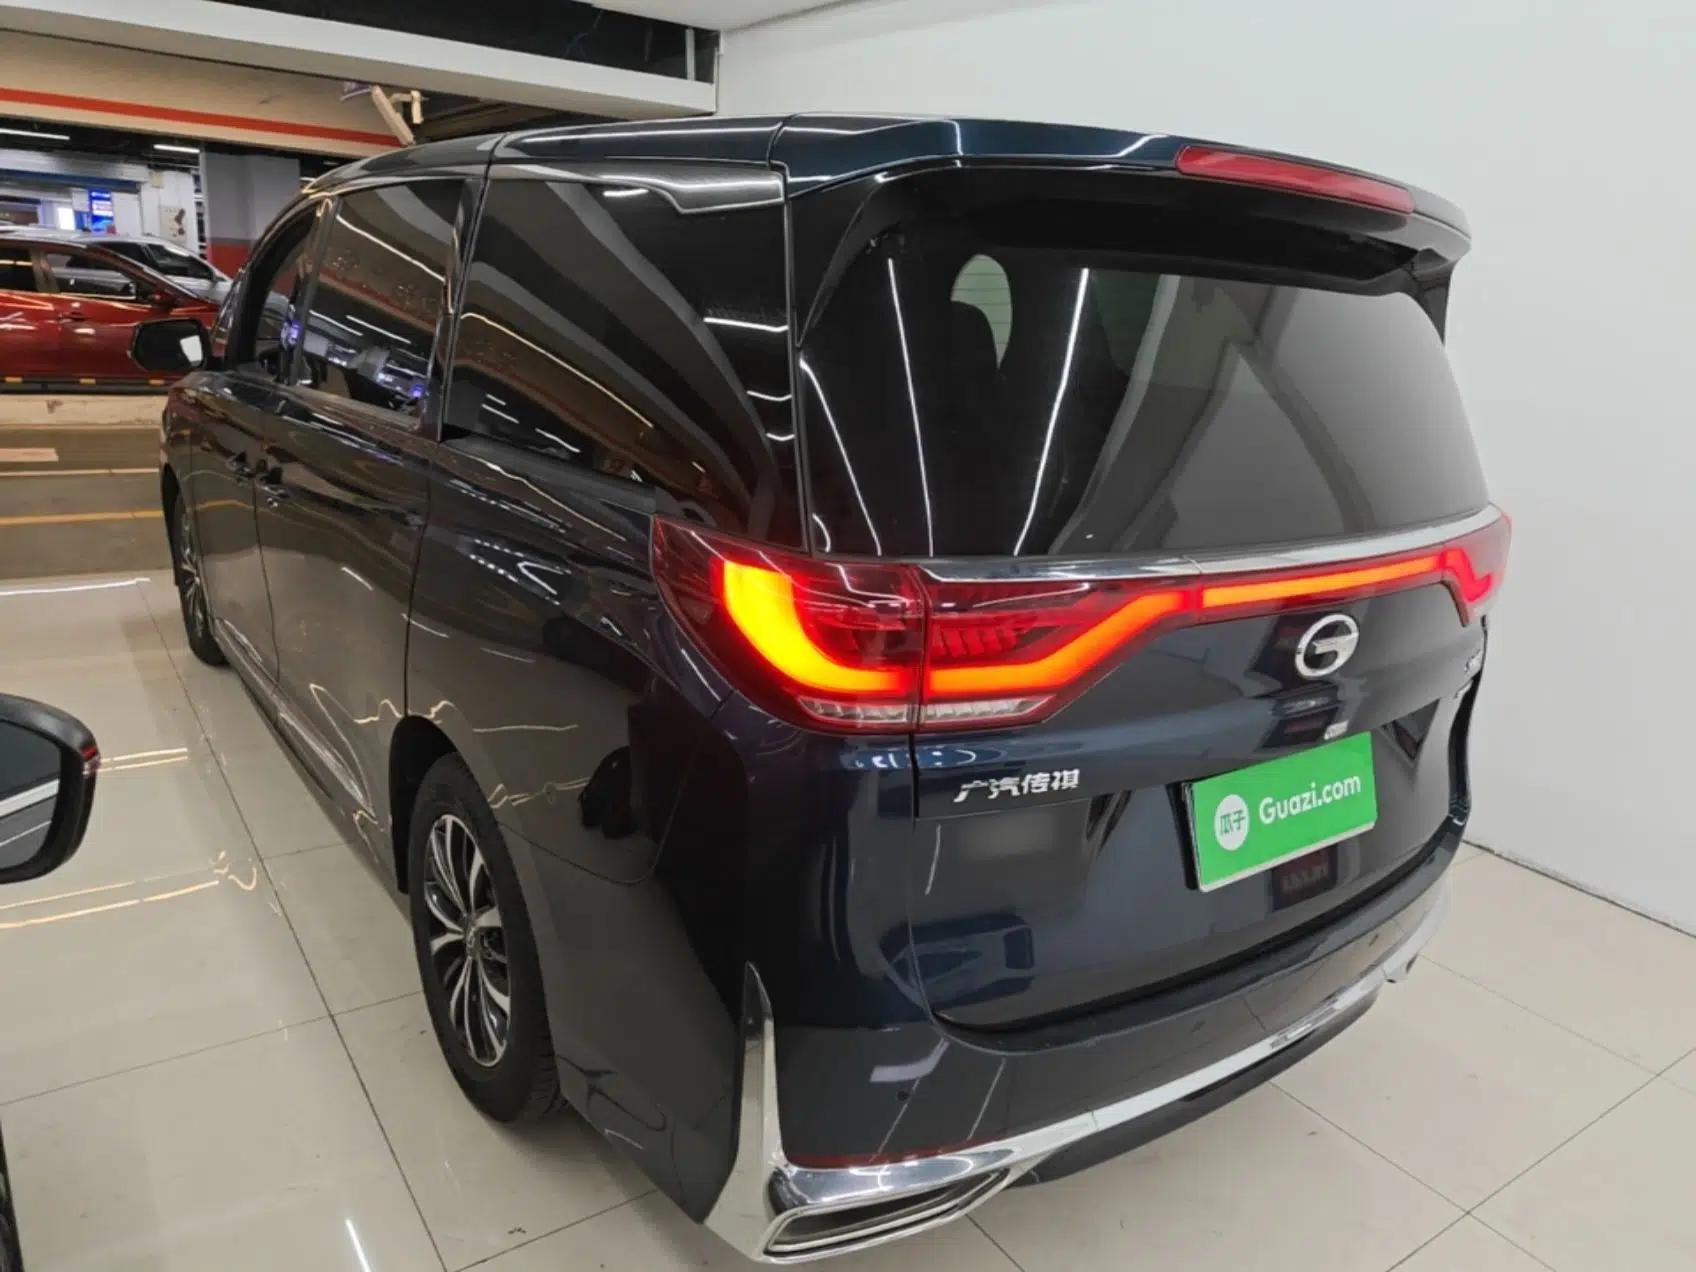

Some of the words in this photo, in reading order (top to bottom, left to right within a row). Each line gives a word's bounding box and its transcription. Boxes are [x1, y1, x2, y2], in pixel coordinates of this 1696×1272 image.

[953, 768, 1080, 802] 广汽传祺
[1259, 775, 1361, 824] Guazi.com
[1220, 809, 1246, 835] 瓜子
